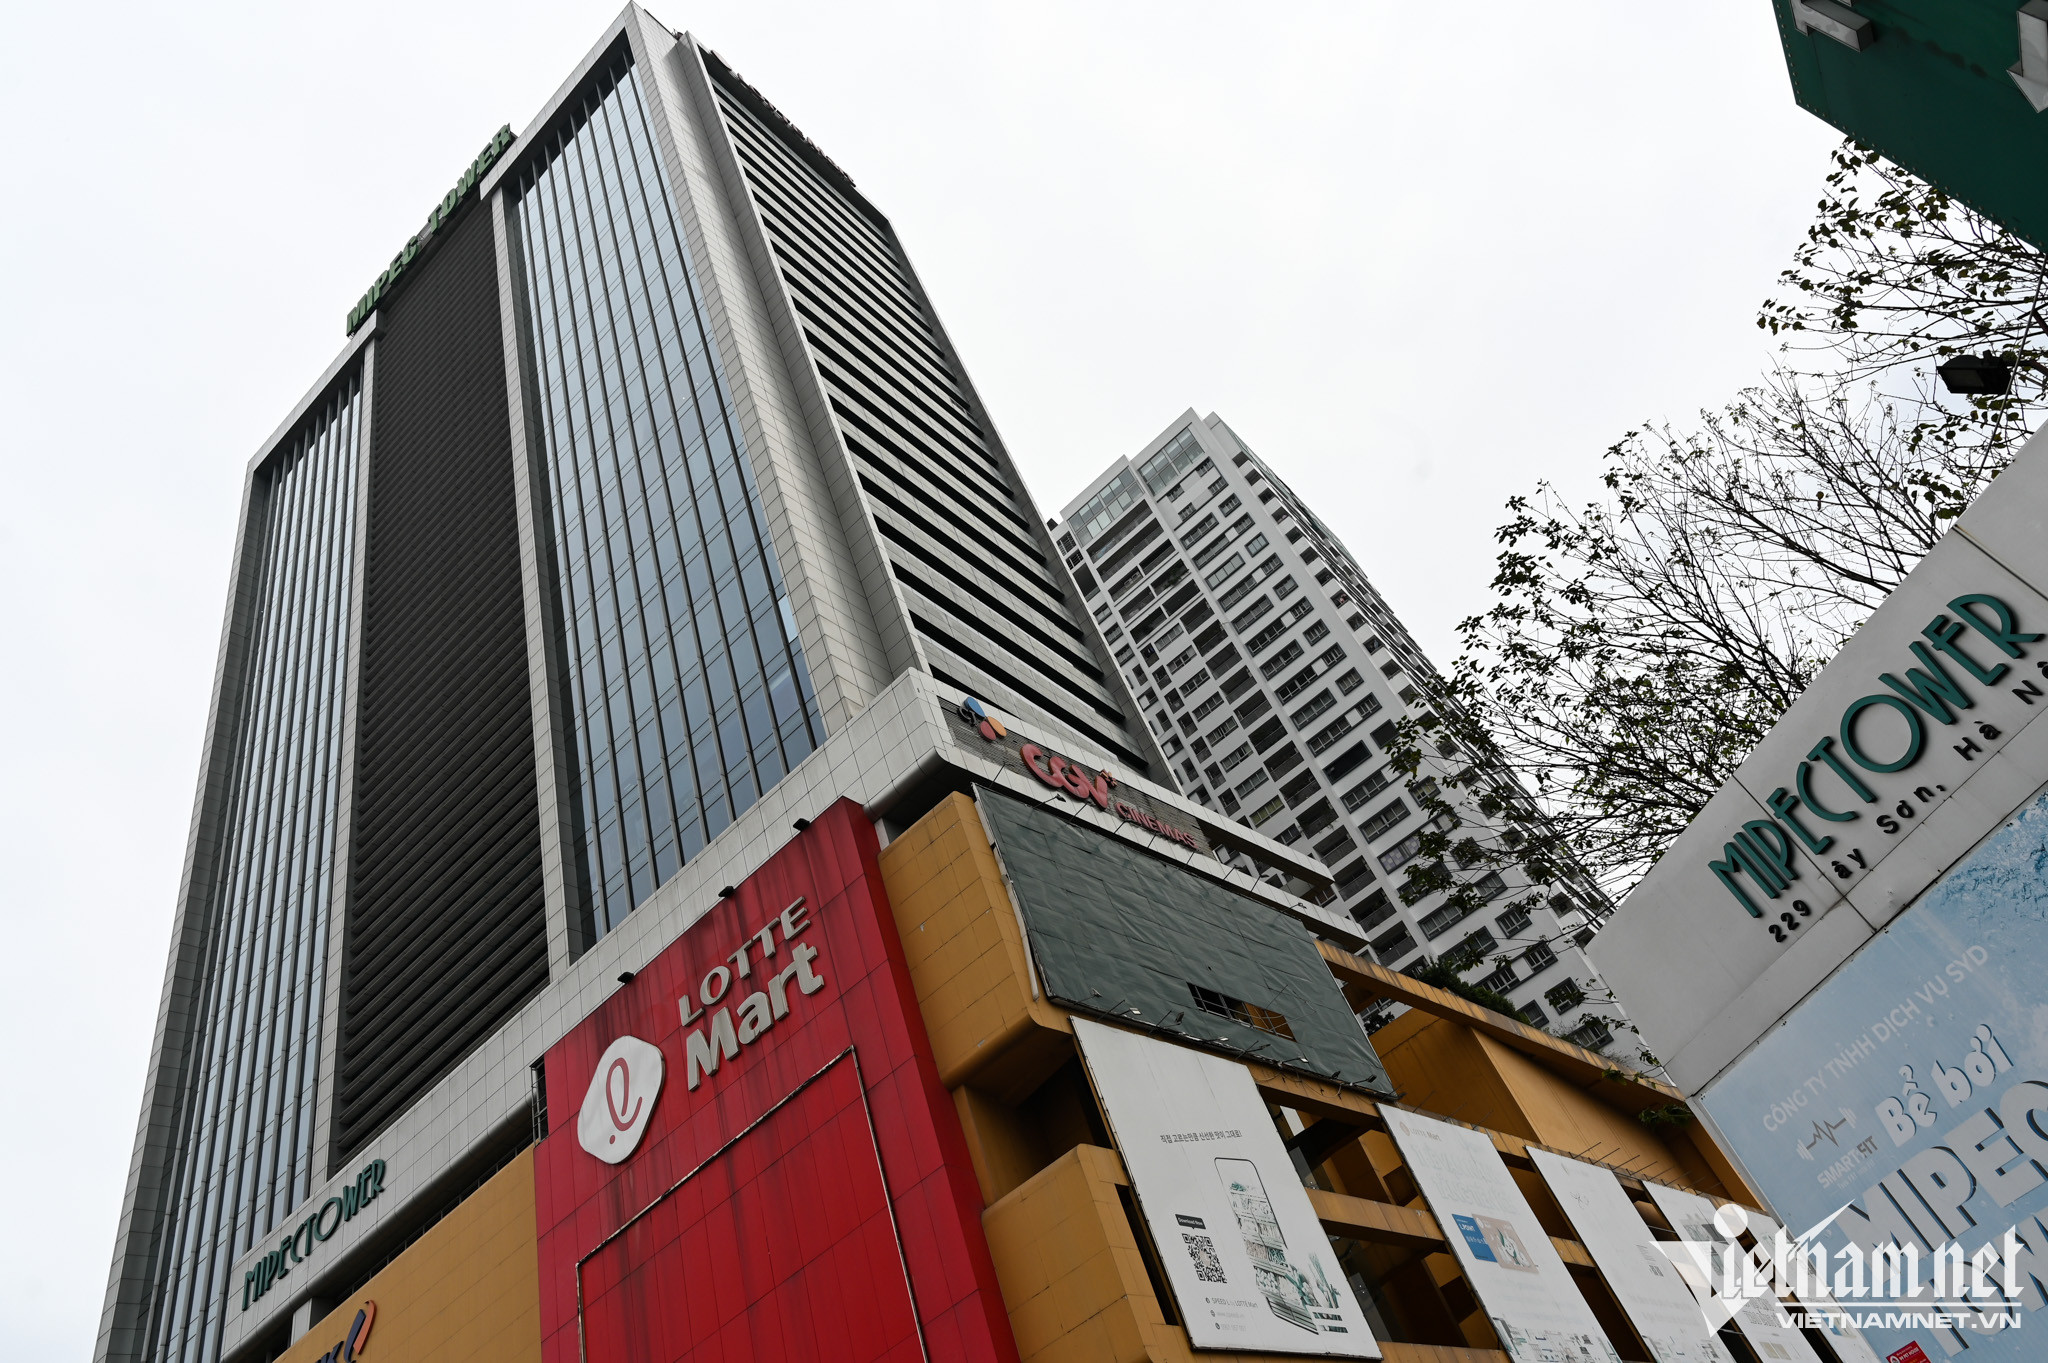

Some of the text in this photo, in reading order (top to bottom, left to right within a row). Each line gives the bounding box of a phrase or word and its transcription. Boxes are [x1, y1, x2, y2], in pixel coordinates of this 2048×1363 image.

[346, 123, 513, 338] MIPEC TOWER
[1019, 743, 1199, 850] CGV CINEMAS
[1767, 898, 1811, 944] 229
[1876, 782, 1947, 835] Sơn,
[1952, 719, 2002, 761] Hà
[678, 895, 812, 1027] LOTTE
[686, 941, 825, 1092] Mart
[1763, 945, 1989, 1132] CÔNG TY TNHH DỊCH VỤ SYD
[1874, 1023, 2014, 1147] Bể bơi
